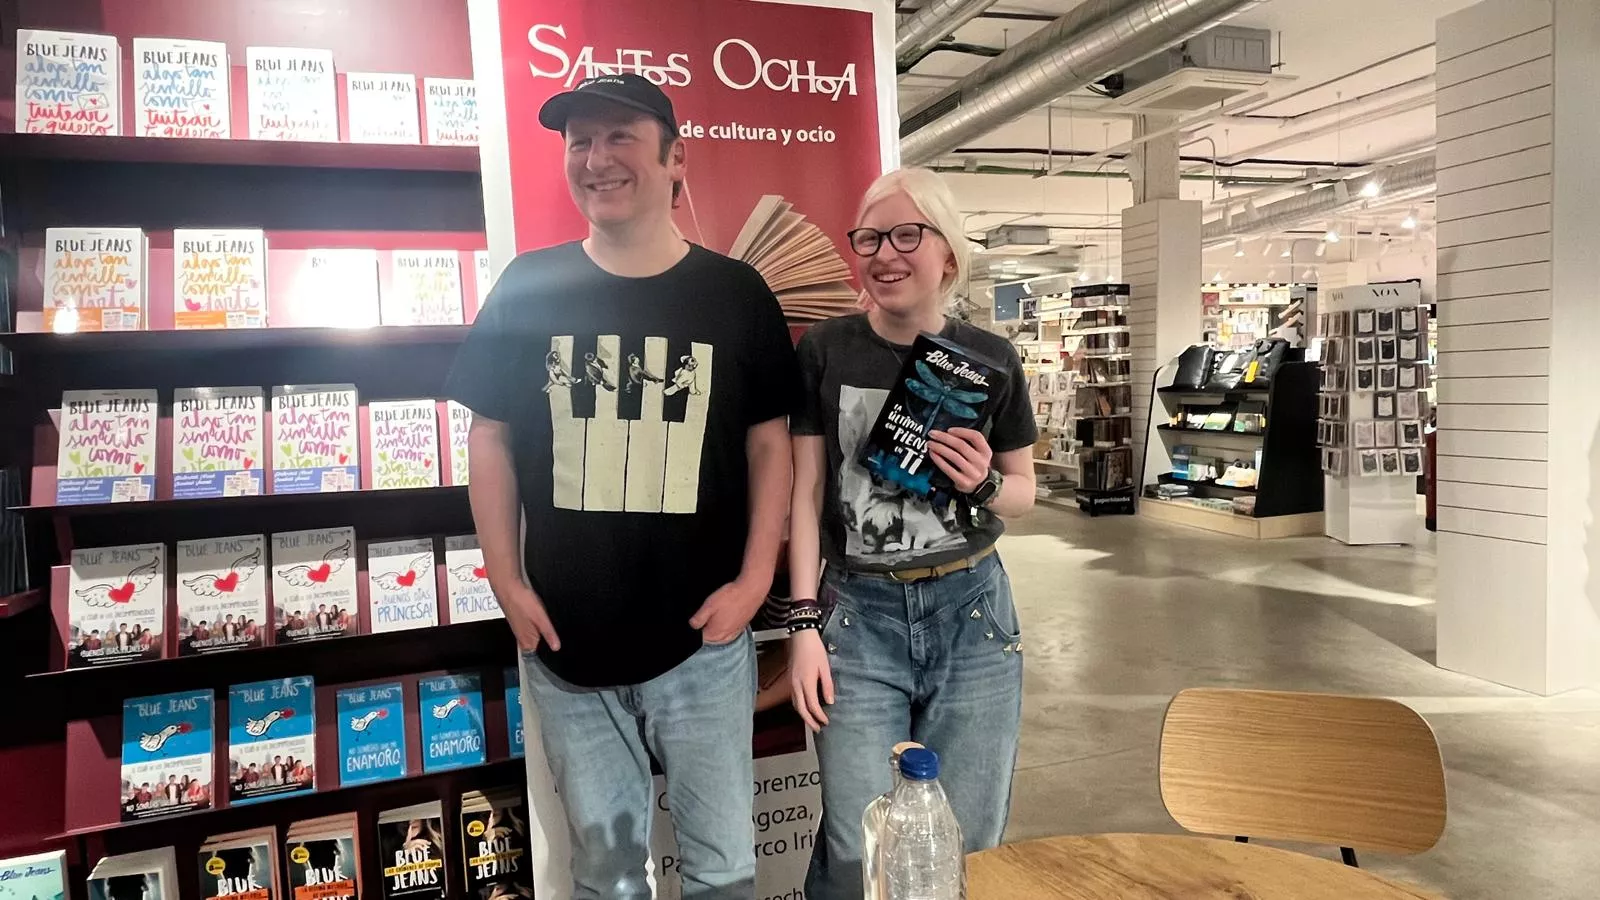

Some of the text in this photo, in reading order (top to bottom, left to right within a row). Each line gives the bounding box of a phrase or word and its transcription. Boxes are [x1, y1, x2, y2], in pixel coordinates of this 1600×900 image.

[26, 43, 108, 61] BLUE JEANS
[143, 51, 218, 68] BLUE JEANS
[255, 59, 325, 73] BLUE JEANS
[352, 80, 412, 94] BLUE JEANS
[429, 85, 451, 96] BLUE
[678, 120, 836, 146] de cultura y ocio
[55, 239, 133, 253] BLUE JEANS
[183, 240, 255, 253] BLUE JEANS
[423, 257, 455, 268] JEANS
[926, 350, 990, 387] Blue Jeans
[69, 399, 149, 415] BLUE JEANS
[181, 396, 255, 412] BLUE JEANS
[279, 393, 350, 409] BLUE JEANS
[69, 411, 114, 436] algo
[181, 408, 225, 433] algo
[279, 406, 319, 429] algo
[374, 408, 432, 422] BLUE JEANS
[452, 409, 469, 420] BLU
[893, 427, 928, 453] PIENS
[186, 540, 243, 557] BLUE JEANS
[280, 532, 334, 548] BLUE JEANS
[80, 550, 141, 565] BLUE JEANS
[377, 602, 433, 623] PRINCESA!
[456, 595, 499, 615] PRINCES
[243, 683, 299, 703] BLUE JEANS
[430, 678, 448, 692] BLUE
[349, 690, 392, 704] BLUE JEANS
[138, 698, 198, 717] BLUE JEANS
[429, 735, 481, 759] ENAMORO
[346, 748, 400, 773] ENAMORO
[755, 771, 821, 795] orenzo
[754, 807, 813, 831] goza,
[755, 829, 813, 858] rco Iri
[395, 849, 431, 867] BLUE
[0, 867, 56, 881] Blue Jeans
[305, 867, 347, 886] BLUE
[476, 856, 518, 879] JEANS
[217, 876, 261, 896] BLUE
[392, 868, 438, 890] JEANS
